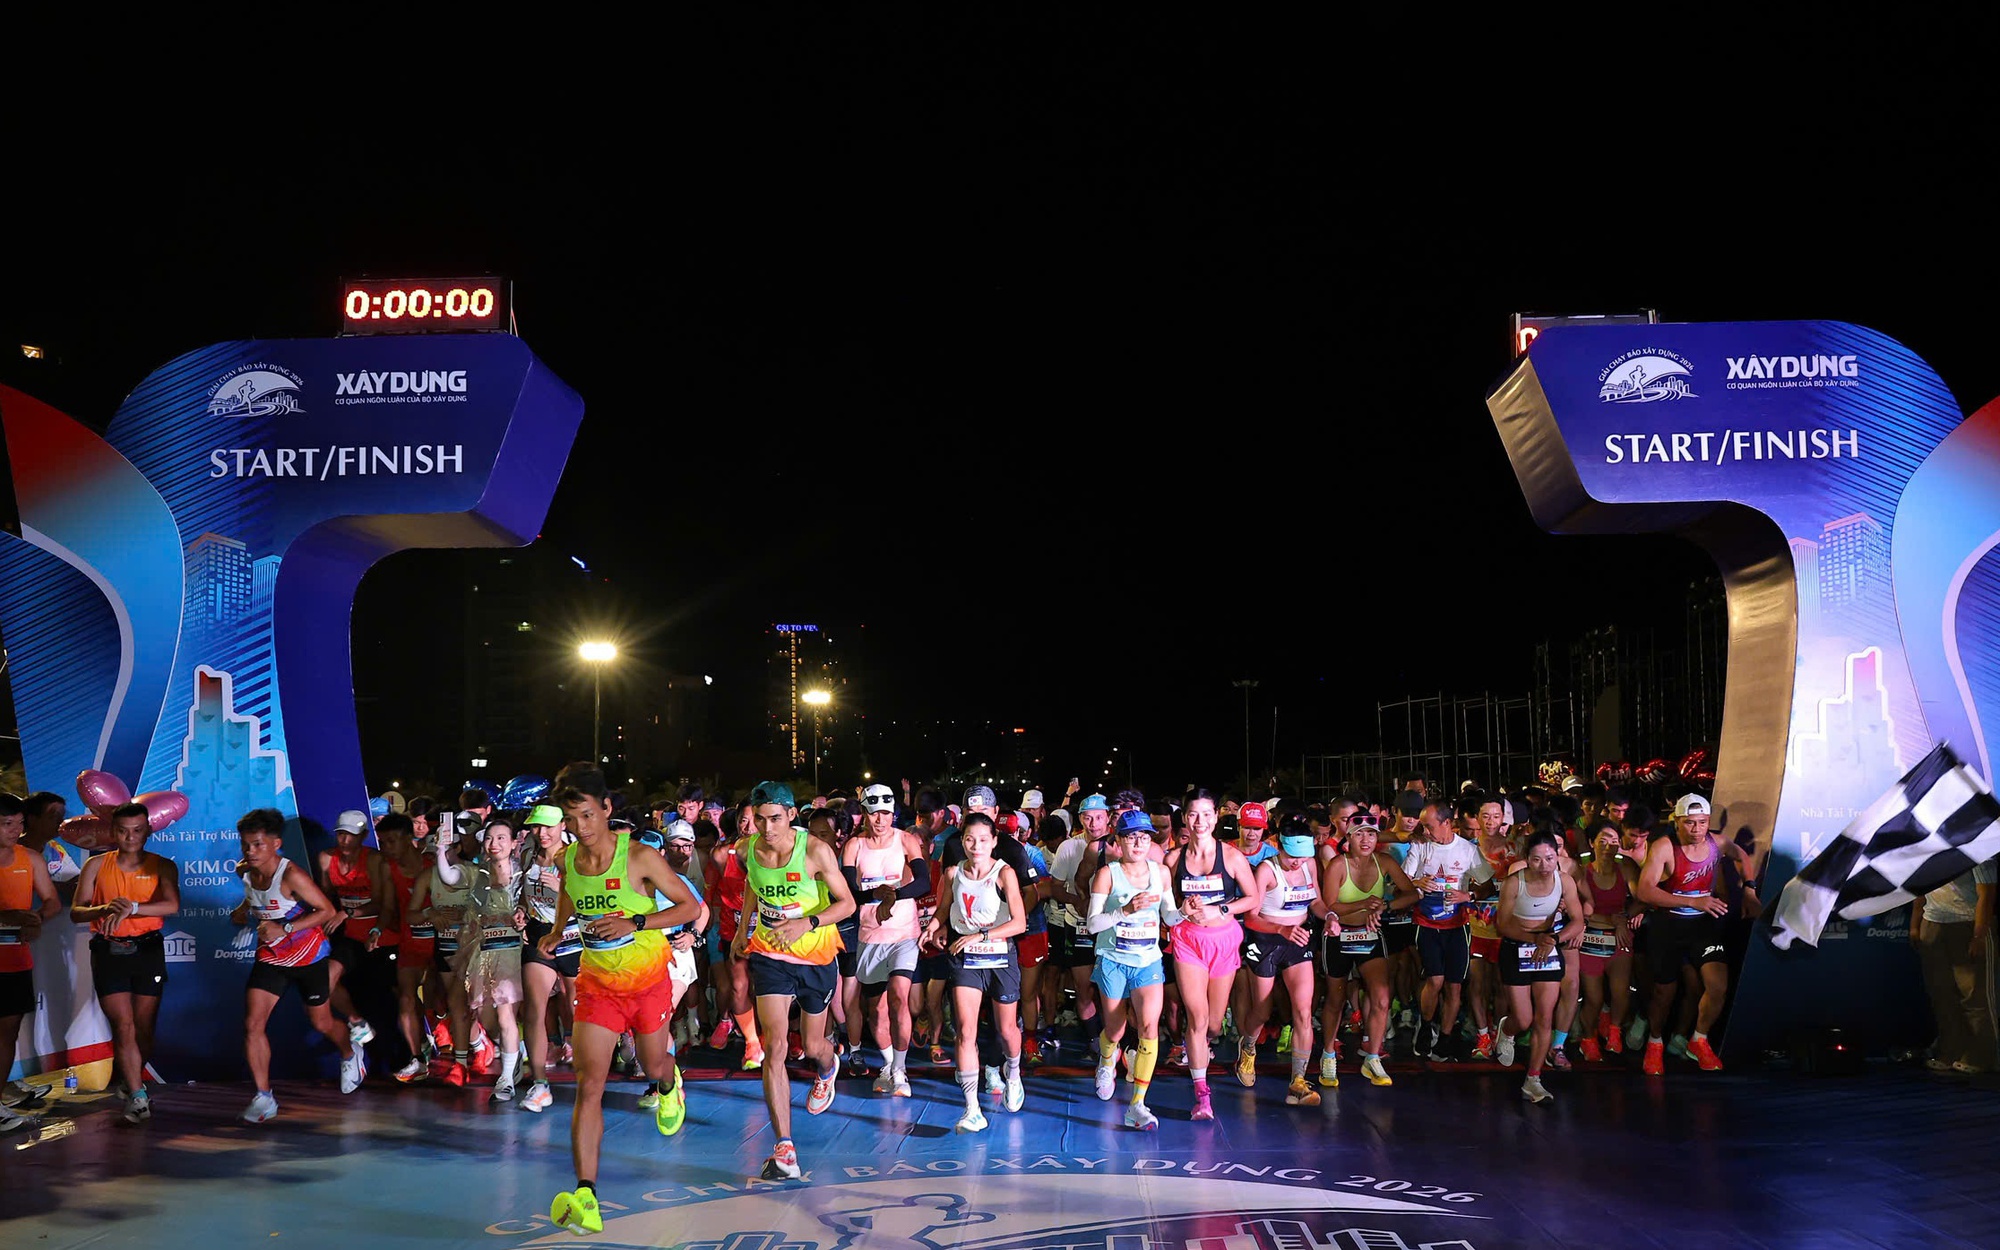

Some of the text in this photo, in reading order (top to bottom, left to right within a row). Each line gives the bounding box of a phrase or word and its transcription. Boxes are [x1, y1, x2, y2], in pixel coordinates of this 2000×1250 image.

[345, 288, 494, 320] 0:00:00
[1679, 357, 1695, 371] 2026
[1737, 382, 1757, 390] QUAN
[1824, 379, 1839, 387] XÂY
[345, 397, 365, 405] QUAN
[1604, 429, 1859, 466] START/FINISH
[210, 445, 463, 481] START/FINISH
[152, 832, 175, 843] Nhà
[179, 831, 195, 841] Tài
[199, 831, 217, 843] Trợ
[184, 860, 219, 874] KIM
[184, 876, 229, 887] GROUP
[576, 894, 617, 910] eBRC
[1867, 927, 1909, 938] Dongta
[214, 949, 256, 960] Dongta
[968, 945, 995, 953] 21564
[990, 1154, 1109, 1170] XÂY
[1334, 1174, 1484, 1204] 2026
